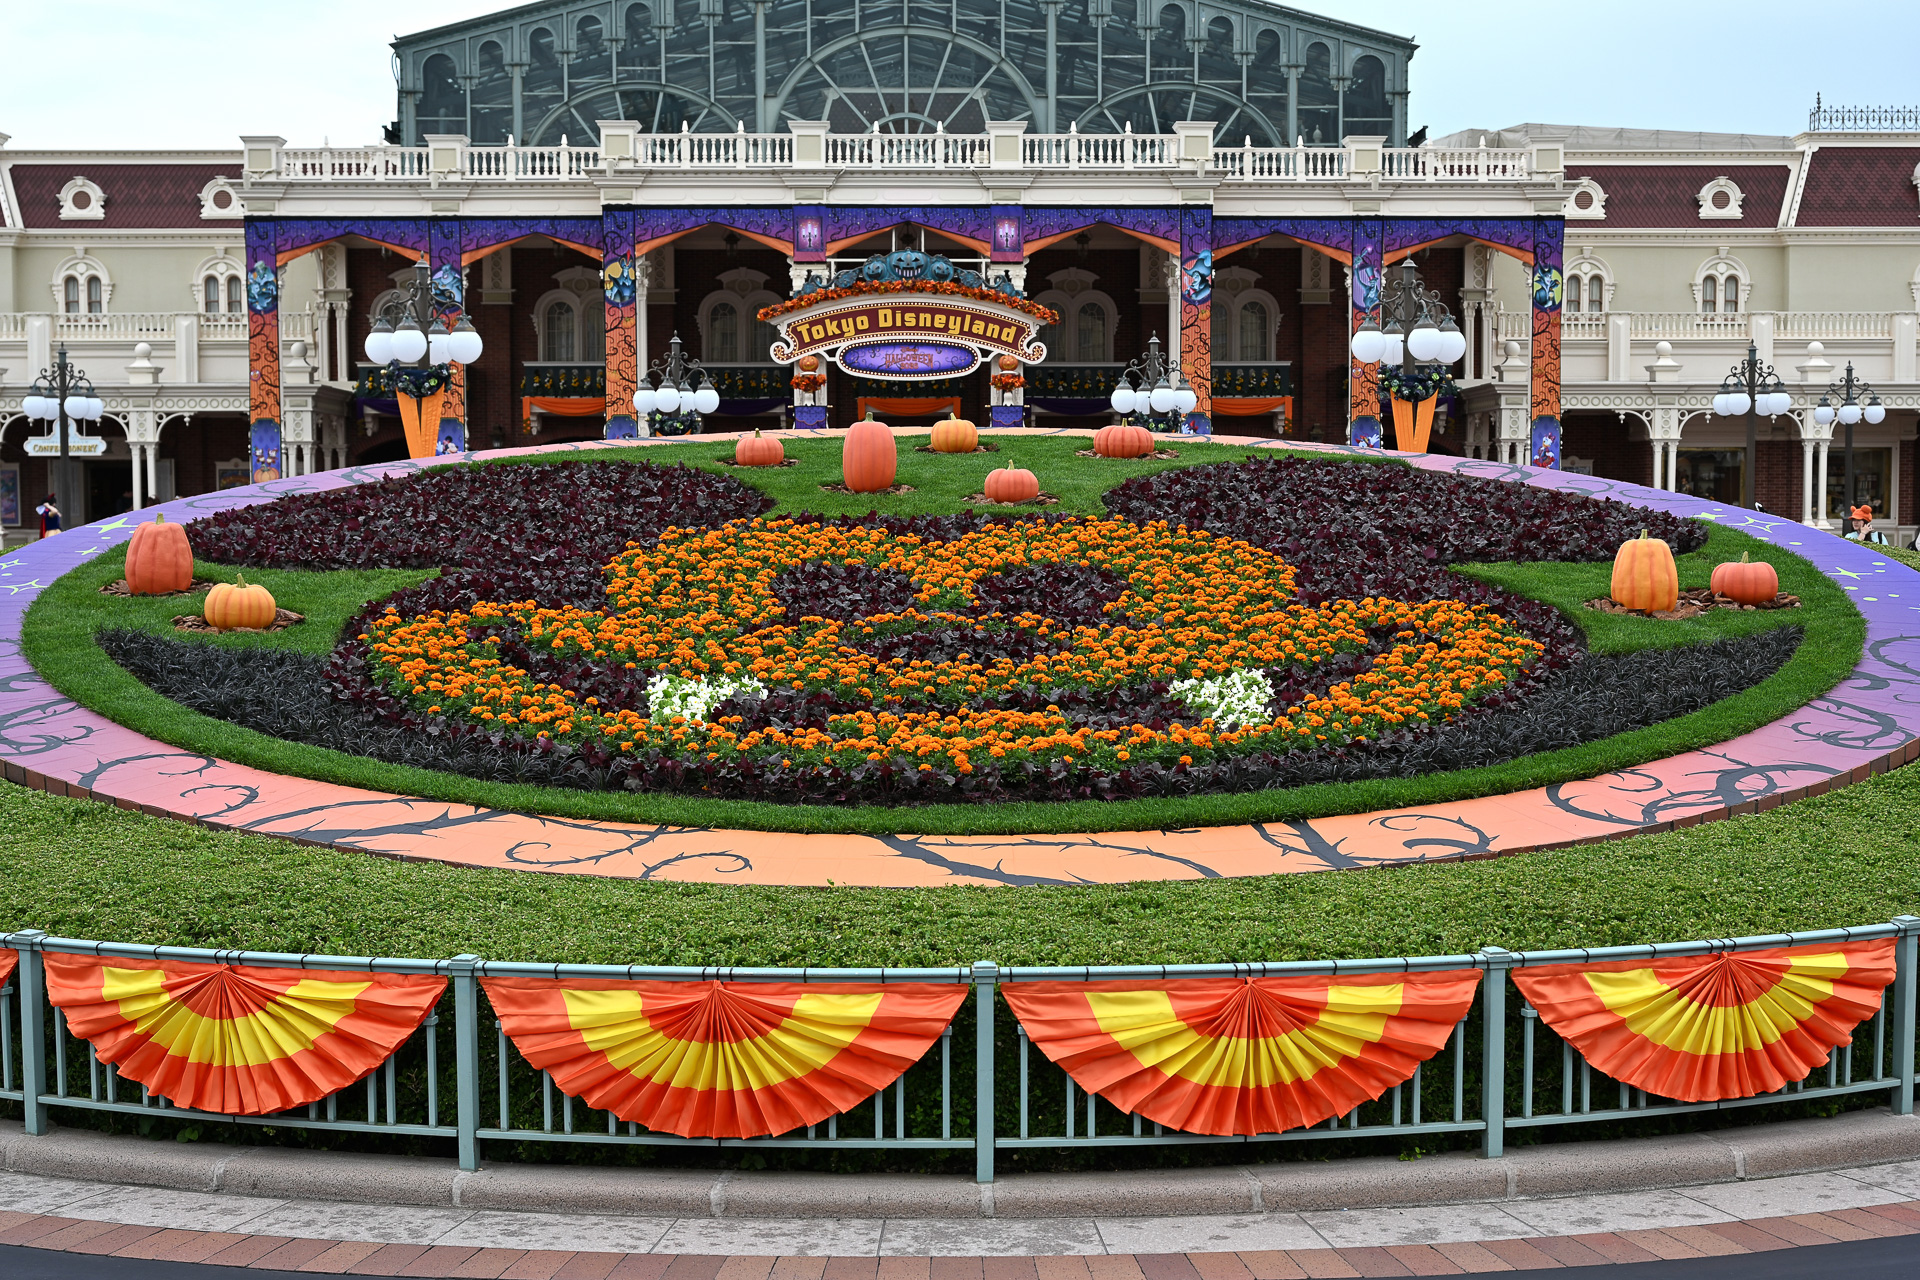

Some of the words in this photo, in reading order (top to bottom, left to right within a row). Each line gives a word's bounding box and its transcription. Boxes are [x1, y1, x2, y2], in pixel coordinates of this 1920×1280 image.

[797, 314, 870, 344] Tokyo
[878, 308, 1017, 344] Disneyland
[885, 353, 934, 369] HALLOWEEN
[33, 444, 98, 453] CONFEIONERY
